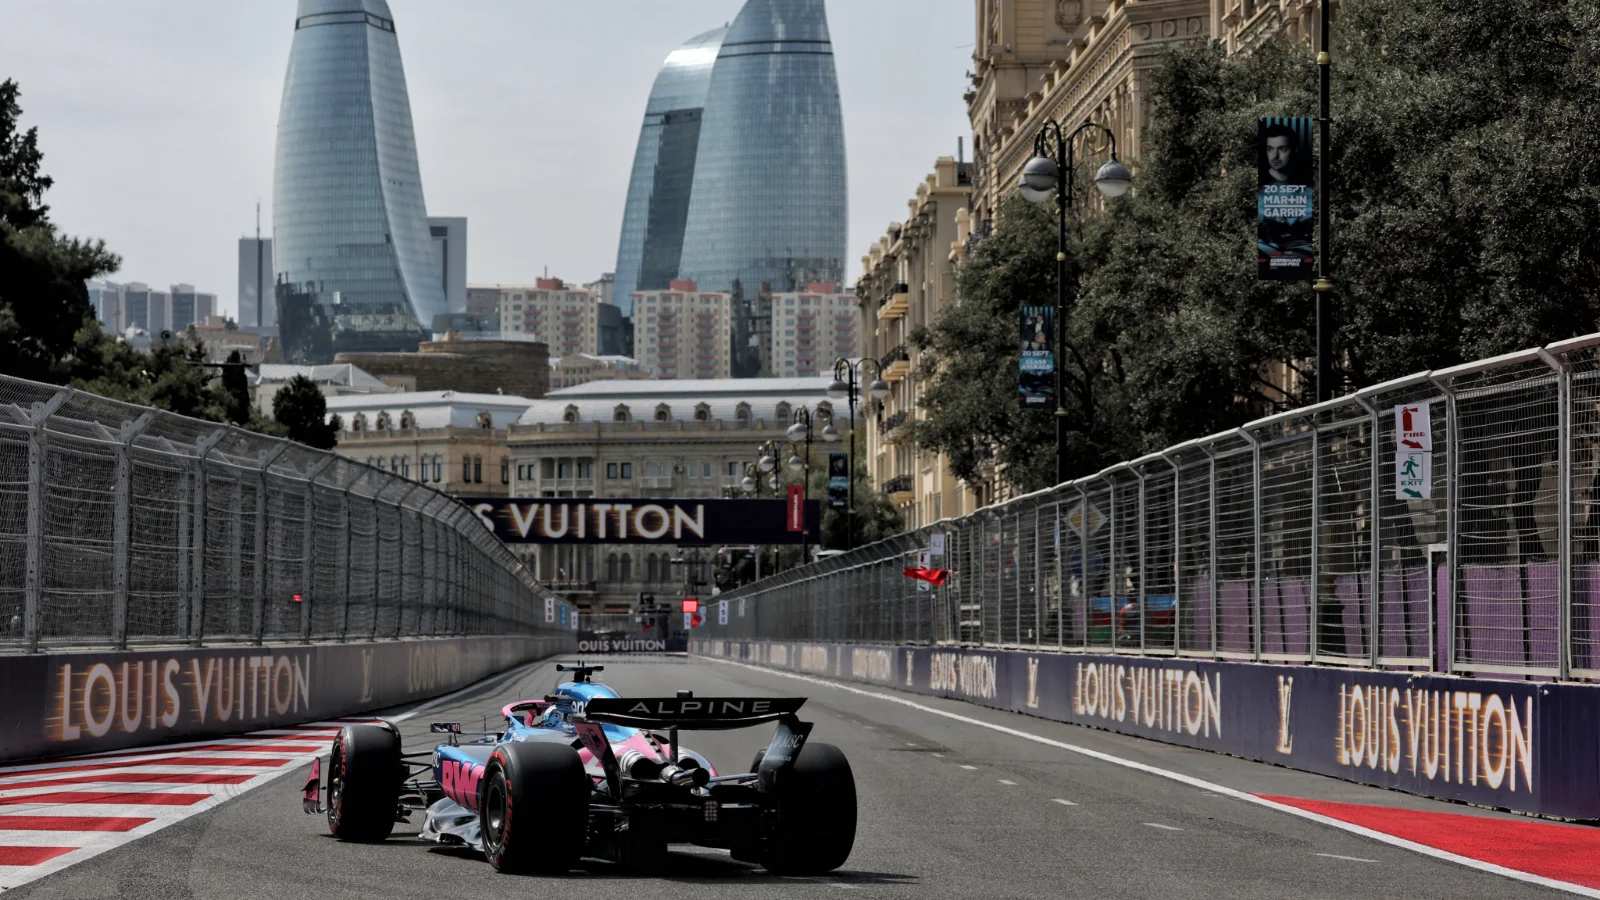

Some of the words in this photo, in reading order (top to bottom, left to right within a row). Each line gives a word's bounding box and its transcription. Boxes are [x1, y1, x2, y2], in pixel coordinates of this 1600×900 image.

[1264, 185, 1277, 193] 20
[1280, 185, 1306, 193] SEPT
[1263, 208, 1307, 217] GARRIX
[509, 503, 704, 539] VUITTON
[578, 640, 609, 651] OUIS
[612, 639, 666, 651] VUITTON
[62, 658, 180, 742] LOUIS
[192, 654, 310, 725] VUITTON
[627, 701, 771, 714] ALPINE
[1076, 661, 1126, 723] LOUIS
[1130, 666, 1221, 740] VUITTON
[1340, 683, 1400, 775] LOUIS
[1406, 688, 1533, 795] VUITTON
